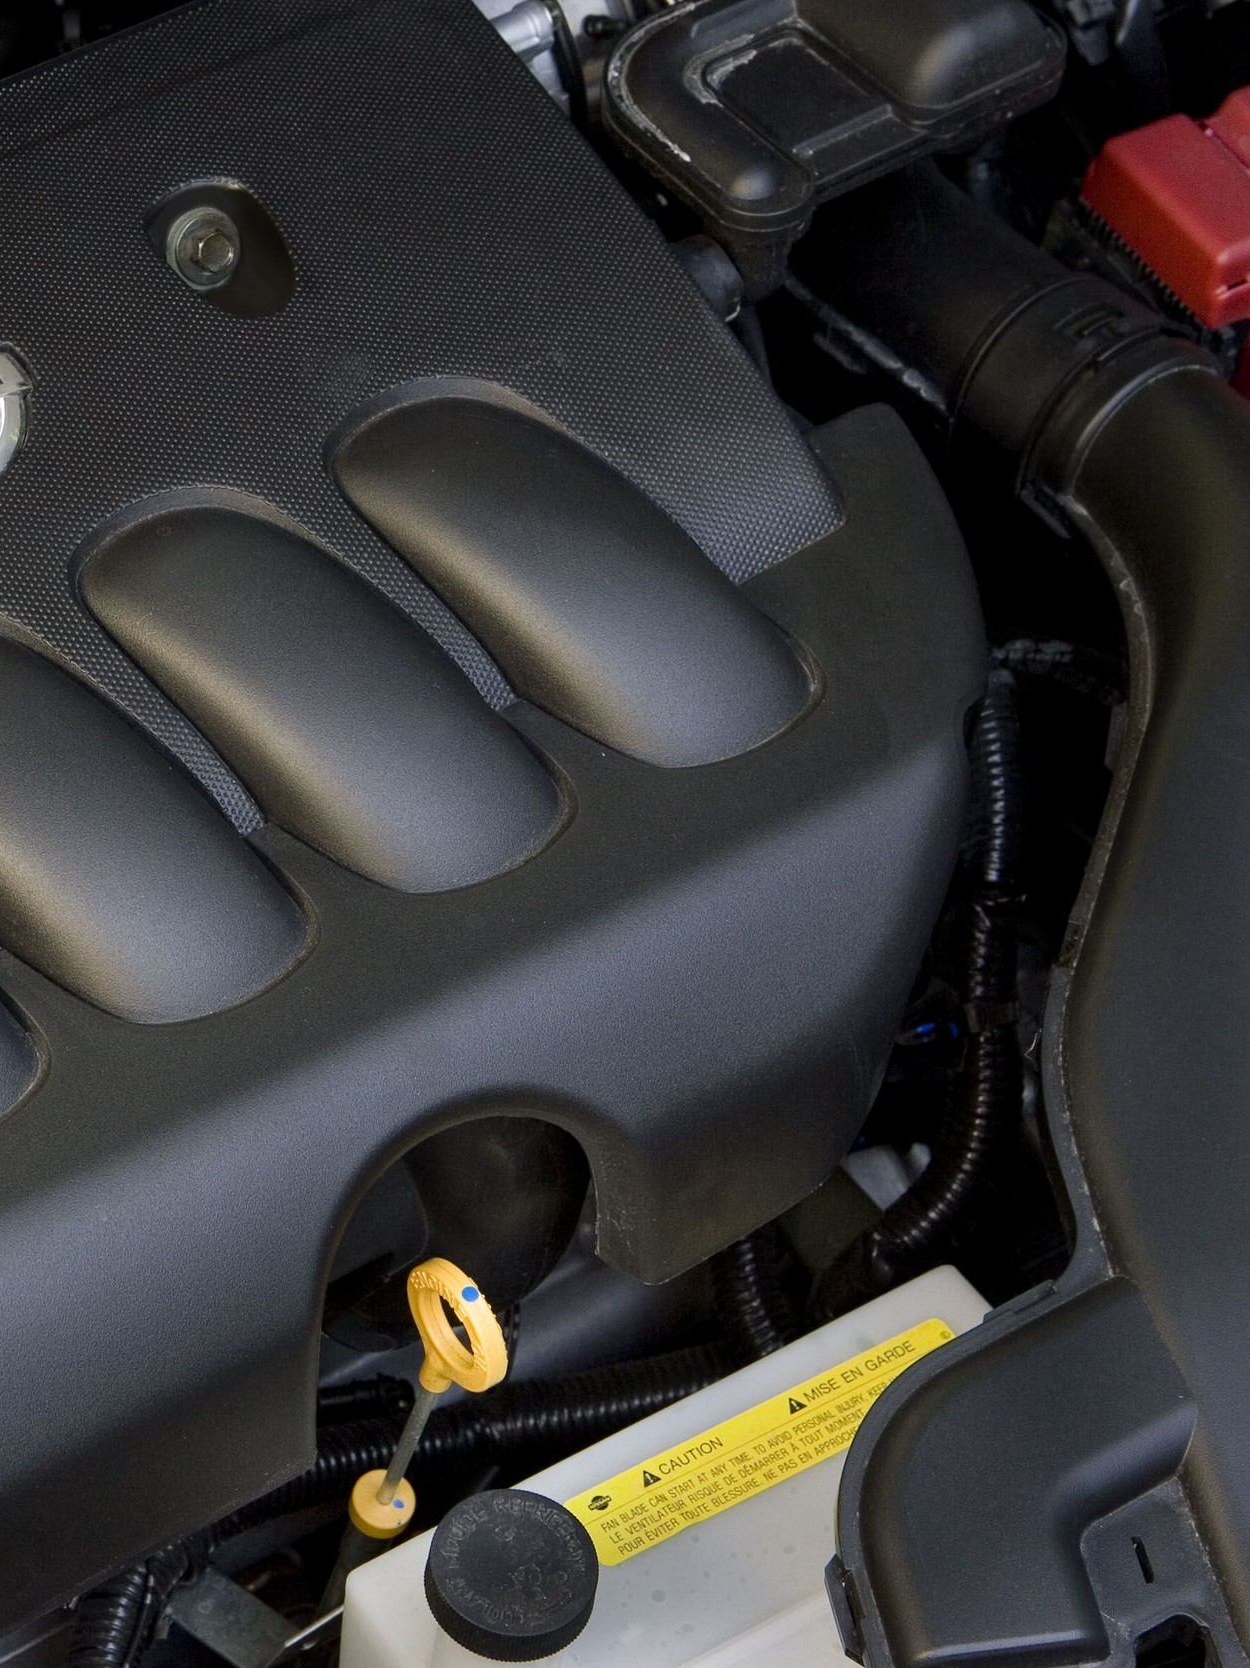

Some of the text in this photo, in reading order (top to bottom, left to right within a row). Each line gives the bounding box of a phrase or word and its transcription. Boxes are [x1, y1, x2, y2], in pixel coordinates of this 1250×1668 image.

[803, 1340, 915, 1403] MISE EN GARDE
[601, 1519, 620, 1533] FAN
[620, 1503, 649, 1523] BLADE
[649, 1494, 667, 1507] CAN
[668, 1480, 696, 1498] START
[698, 1472, 709, 1484] AT
[710, 1462, 728, 1477] ANY
[752, 1444, 767, 1455] TO
[768, 1430, 792, 1448] AVOID
[794, 1408, 835, 1434] PERSONAL
[609, 1531, 623, 1544] LE
[625, 1500, 687, 1535] VENTILATEUR
[687, 1481, 723, 1504] RISQUE
[723, 1474, 738, 1487] DE
[800, 1429, 824, 1446] TOUT
[826, 1408, 865, 1433] MOMENT
[618, 1537, 645, 1555] POUR
[680, 1503, 710, 1522] TOUTE
[763, 1469, 778, 1482] NE
[780, 1460, 798, 1473] PAS
[799, 1451, 814, 1464] EN
[658, 1437, 723, 1475] CAUTION
